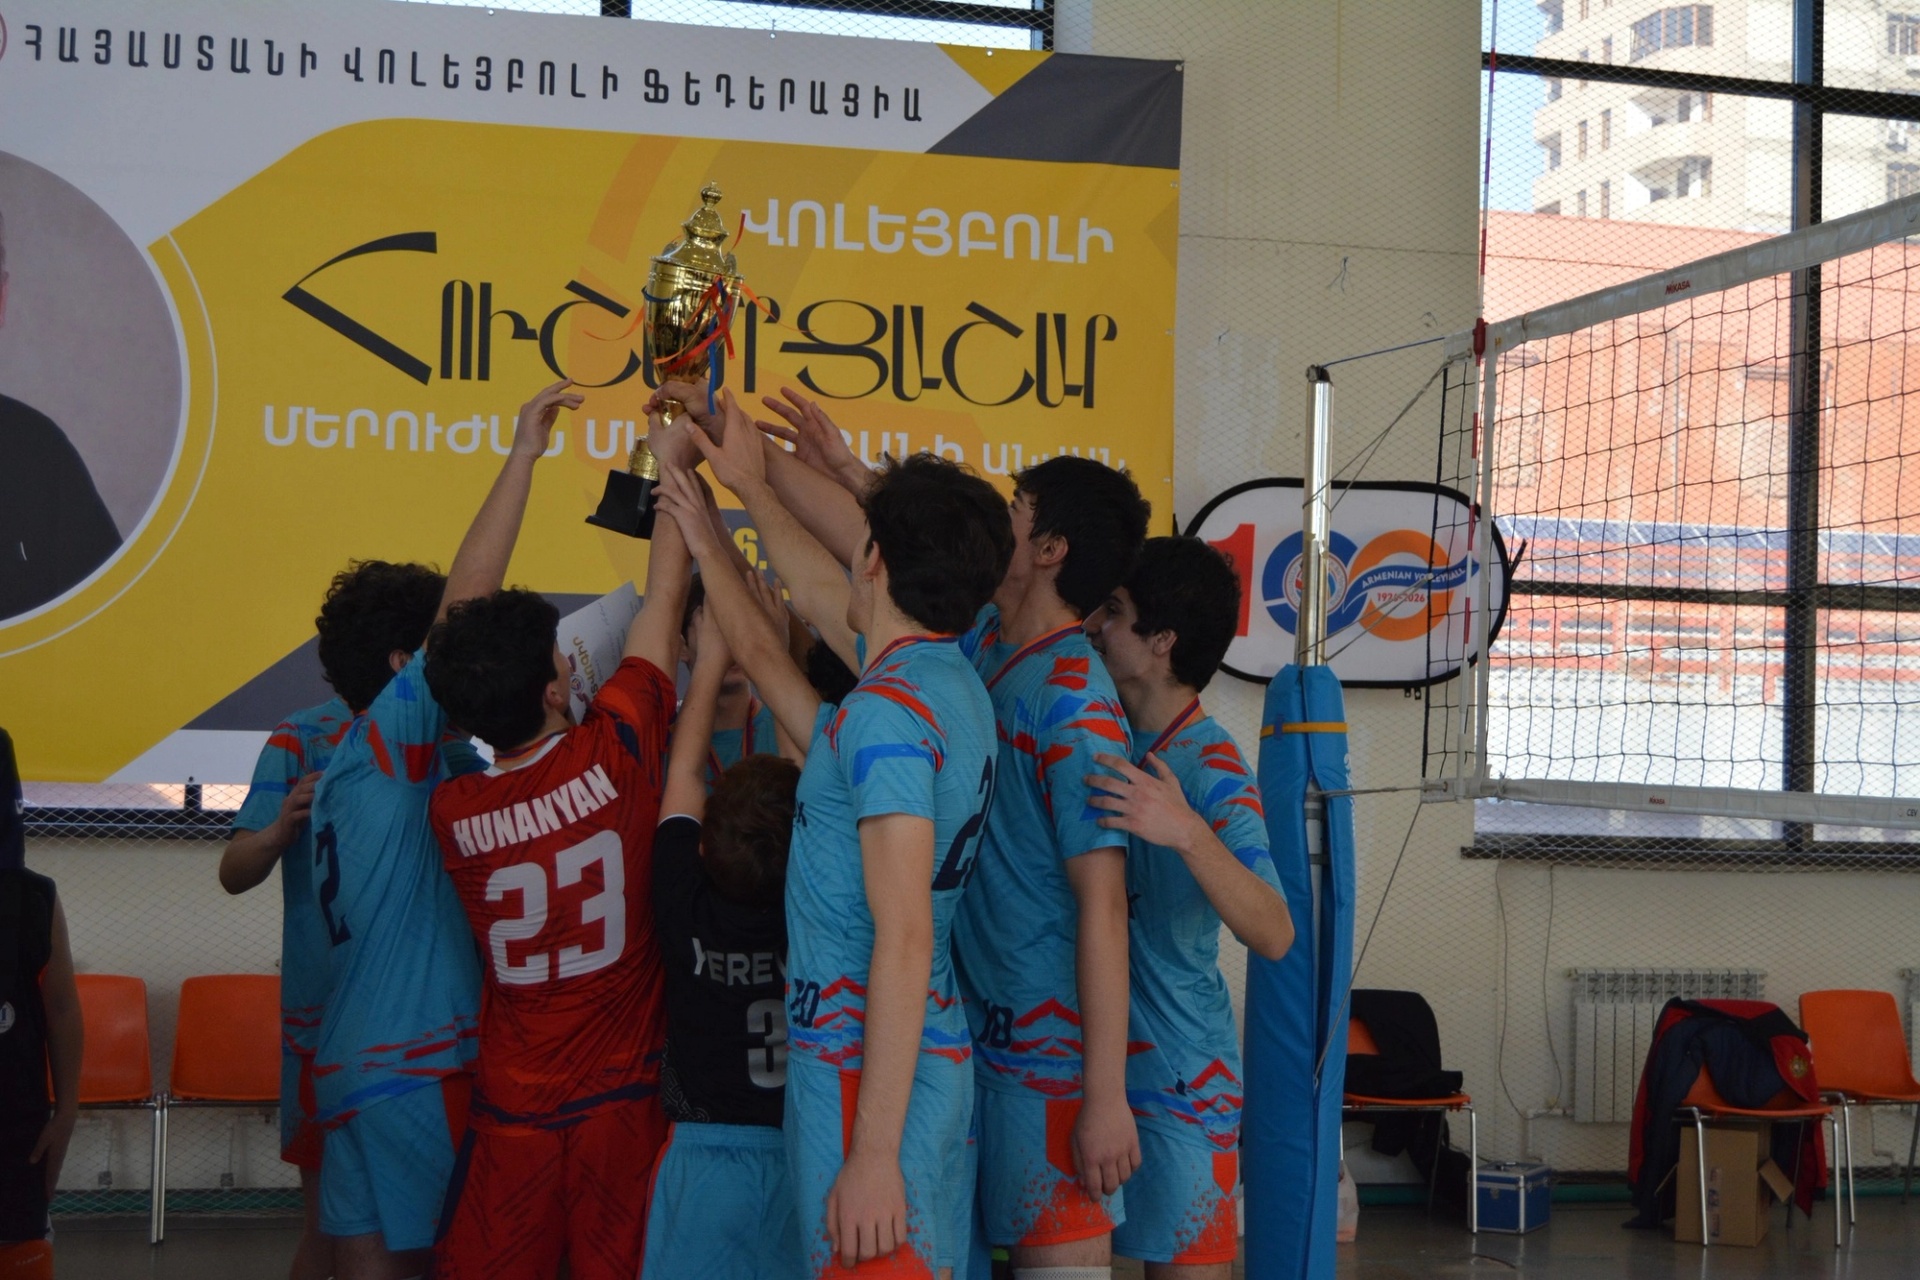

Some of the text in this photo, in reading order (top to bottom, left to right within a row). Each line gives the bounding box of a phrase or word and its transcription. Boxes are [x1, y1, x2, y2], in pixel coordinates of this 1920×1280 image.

[25, 24, 923, 122] ՀԱՅԱՍՏԱՆԻ ՎՈԼԵՅԲՈԼԻ ՖԵԴԵՐԱՑԻԱ
[742, 197, 1115, 265] ՎՈԼԵՅԲՈԼԻ
[1665, 280, 1691, 294] MIKASA
[1361, 570, 1412, 590] ARMENIAN
[452, 763, 619, 858] HUNANYAN
[485, 829, 627, 985] 23
